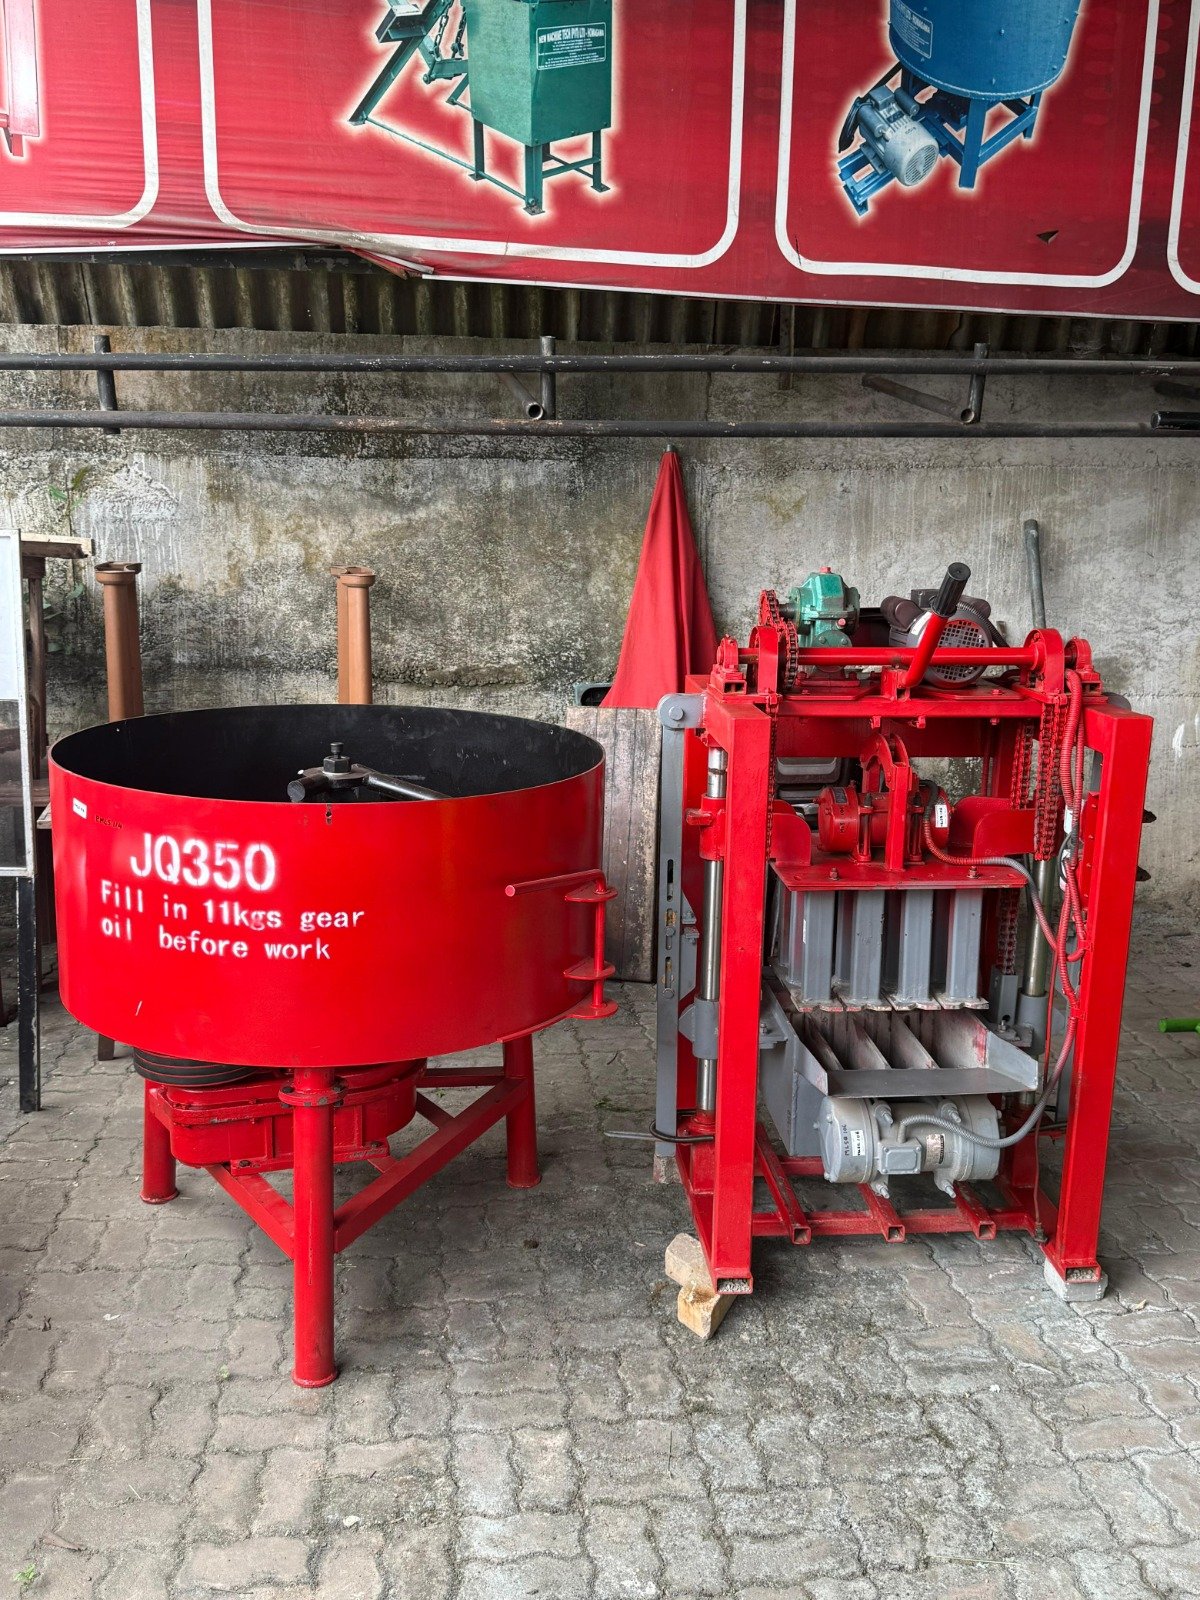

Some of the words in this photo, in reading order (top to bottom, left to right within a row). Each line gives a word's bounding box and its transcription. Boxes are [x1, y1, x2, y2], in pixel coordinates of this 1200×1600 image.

[130, 833, 275, 890] JQ350
[101, 879, 144, 913] Fill
[163, 894, 187, 920] in
[203, 899, 283, 931] 11kgs
[300, 910, 365, 932] gear
[101, 916, 132, 941] oil
[159, 925, 248, 958] before
[264, 938, 331, 960] work
